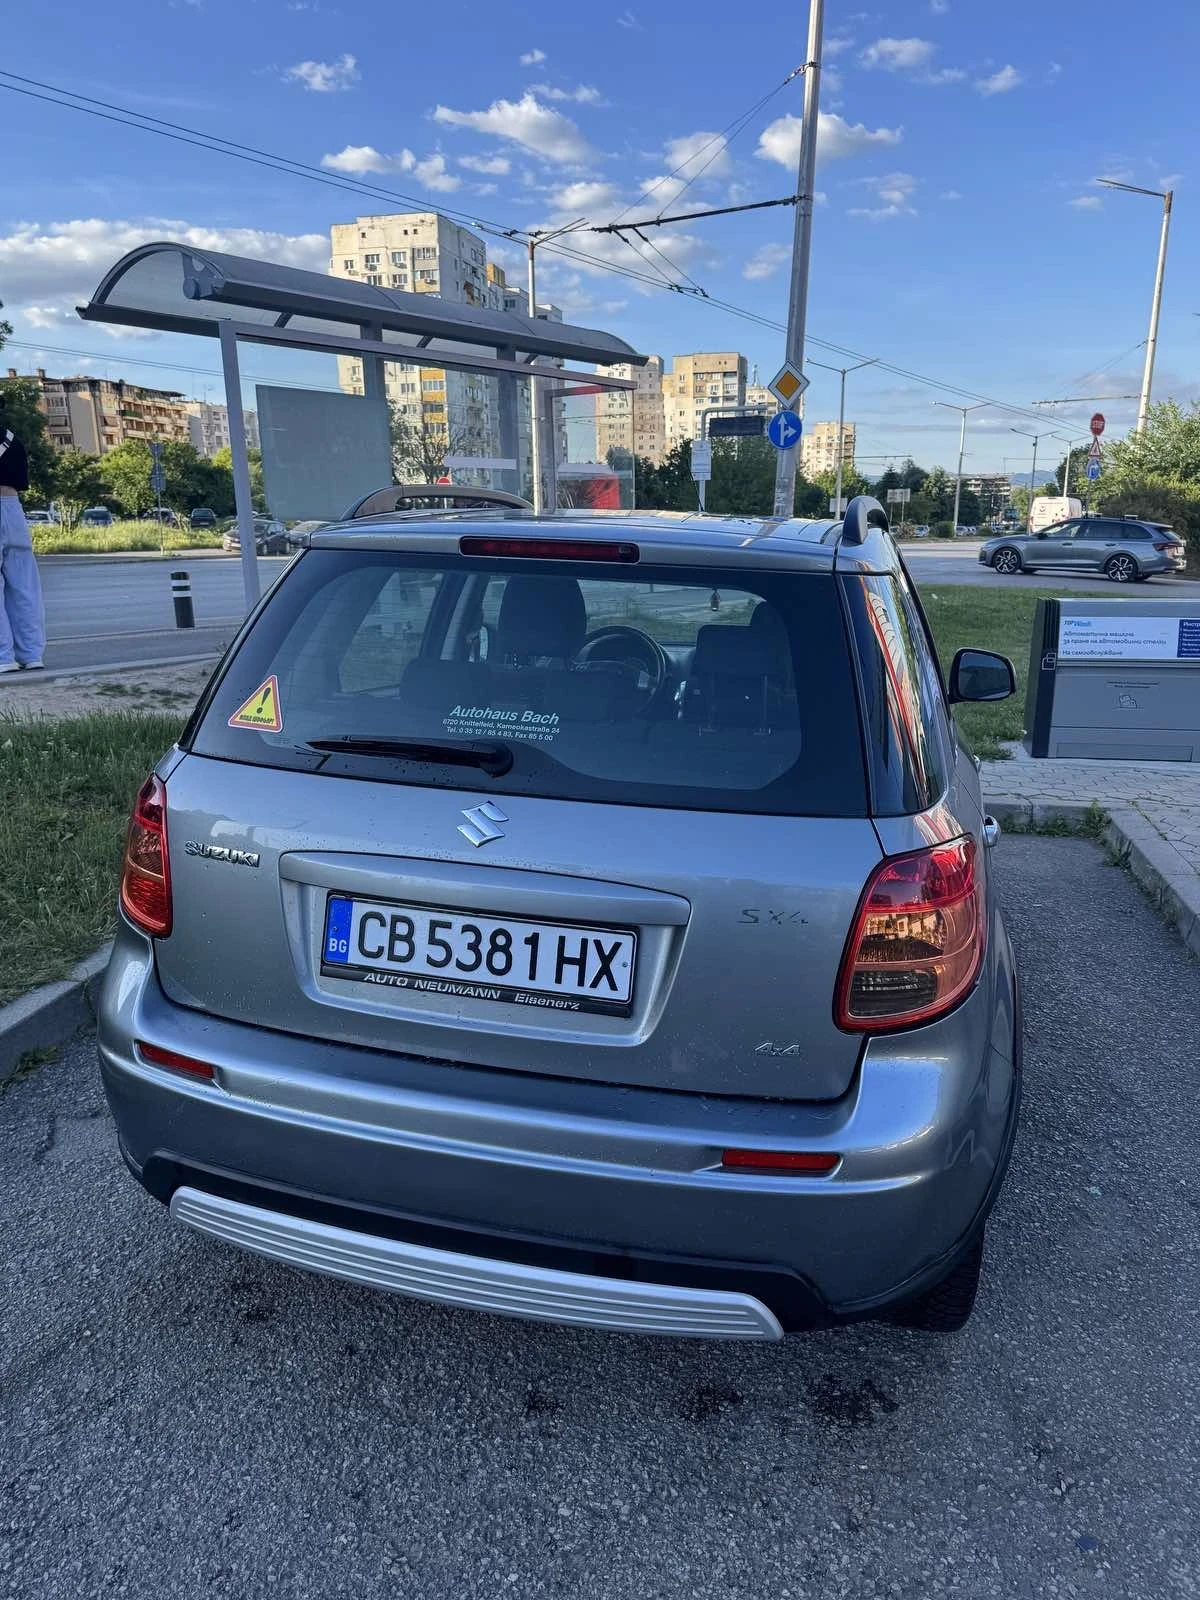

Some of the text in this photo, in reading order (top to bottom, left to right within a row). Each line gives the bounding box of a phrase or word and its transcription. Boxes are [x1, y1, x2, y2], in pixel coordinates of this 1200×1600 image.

[449, 705, 560, 725] Autohaus Bach
[459, 719, 495, 729] Knittelfeld,
[515, 731, 527, 739] Fax
[184, 840, 260, 868] SUZUKI
[736, 907, 809, 925] SX4
[328, 937, 348, 954] BG
[425, 919, 541, 982] 5381
[363, 971, 582, 1011] AUTO NEUMANN Eisenerz
[754, 1041, 801, 1057] 4x4
